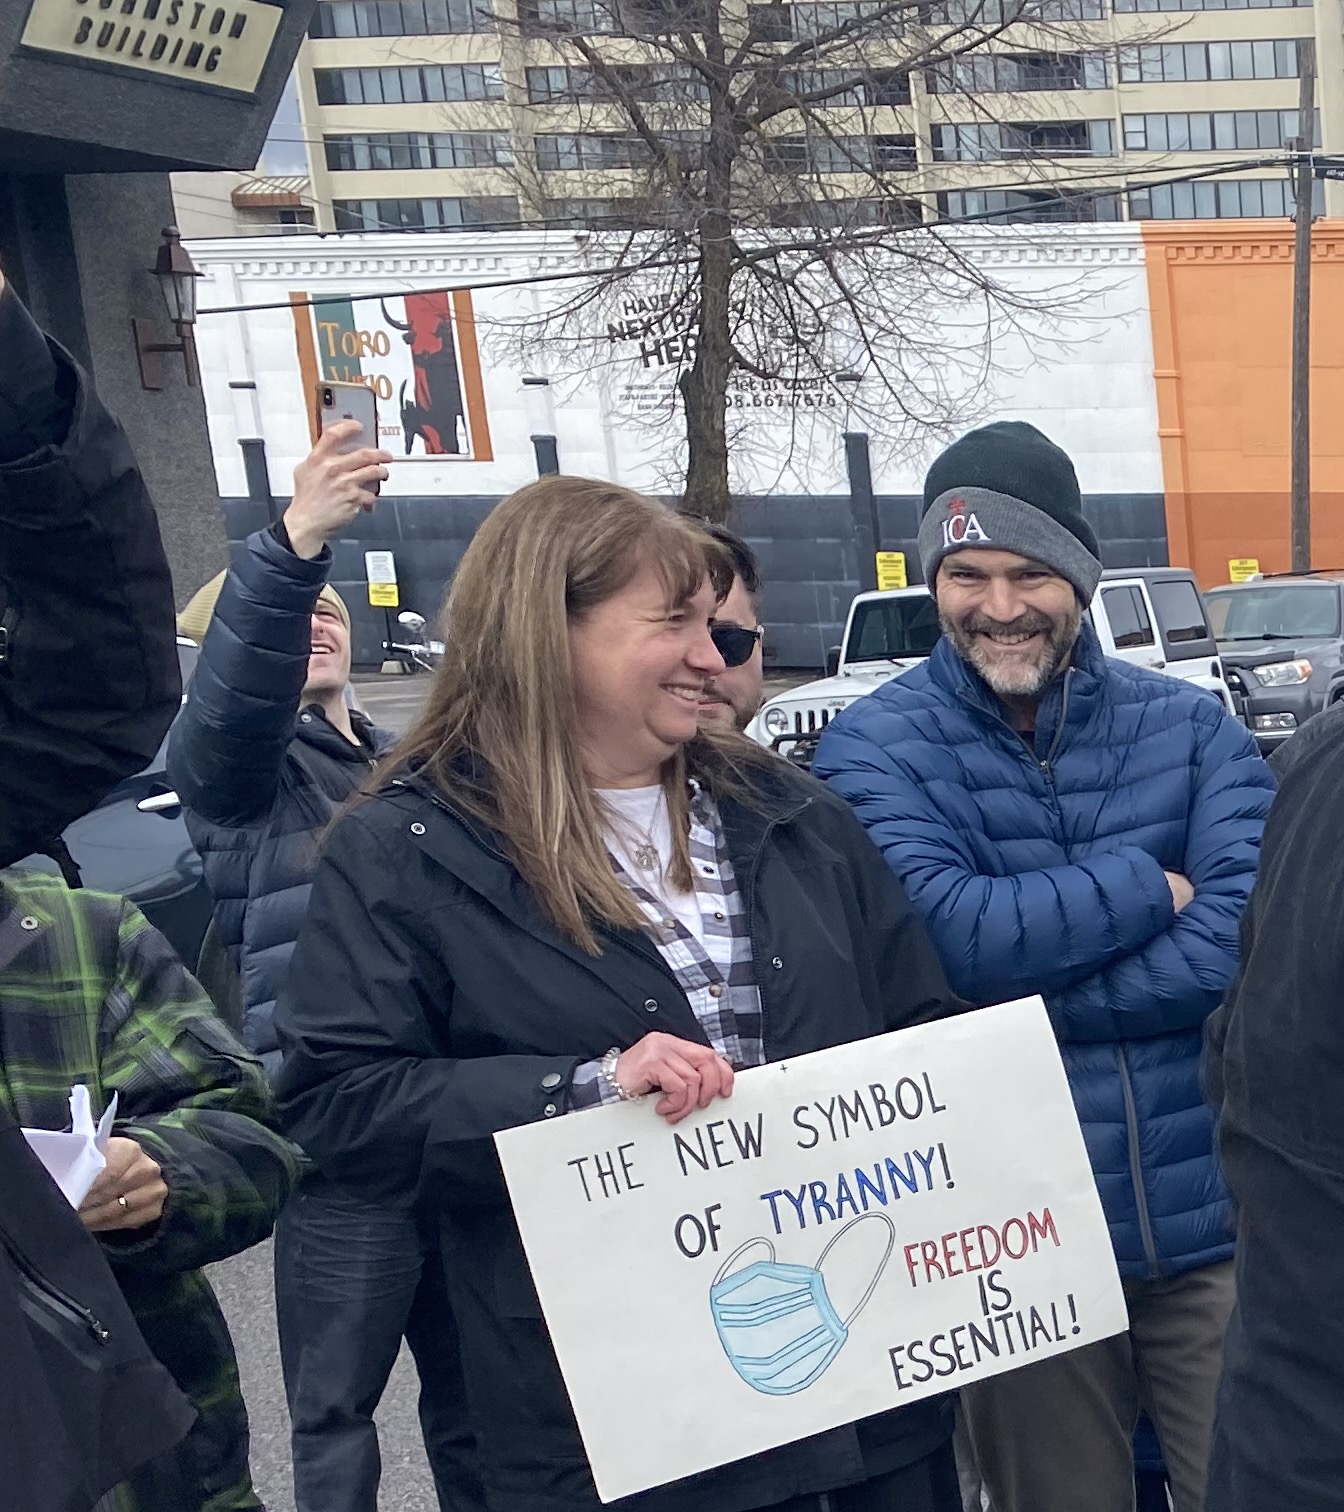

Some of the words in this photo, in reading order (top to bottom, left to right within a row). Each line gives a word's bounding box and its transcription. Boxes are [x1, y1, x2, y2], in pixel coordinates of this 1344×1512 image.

[74, 16, 222, 72] BUILDING
[607, 314, 667, 343] NEXT
[623, 293, 671, 316] HAVE
[639, 334, 699, 368] HER
[941, 513, 991, 547] ICA
[569, 1142, 645, 1202] THE
[674, 1113, 763, 1176] NEW
[794, 1072, 947, 1150] SYMBOL
[674, 1203, 723, 1258] OF
[760, 1142, 955, 1235] TYRANNY!
[904, 1207, 1060, 1288] FREEDOM
[979, 1270, 1012, 1317] IS
[889, 1294, 1082, 1391] ESSENTIAL!
